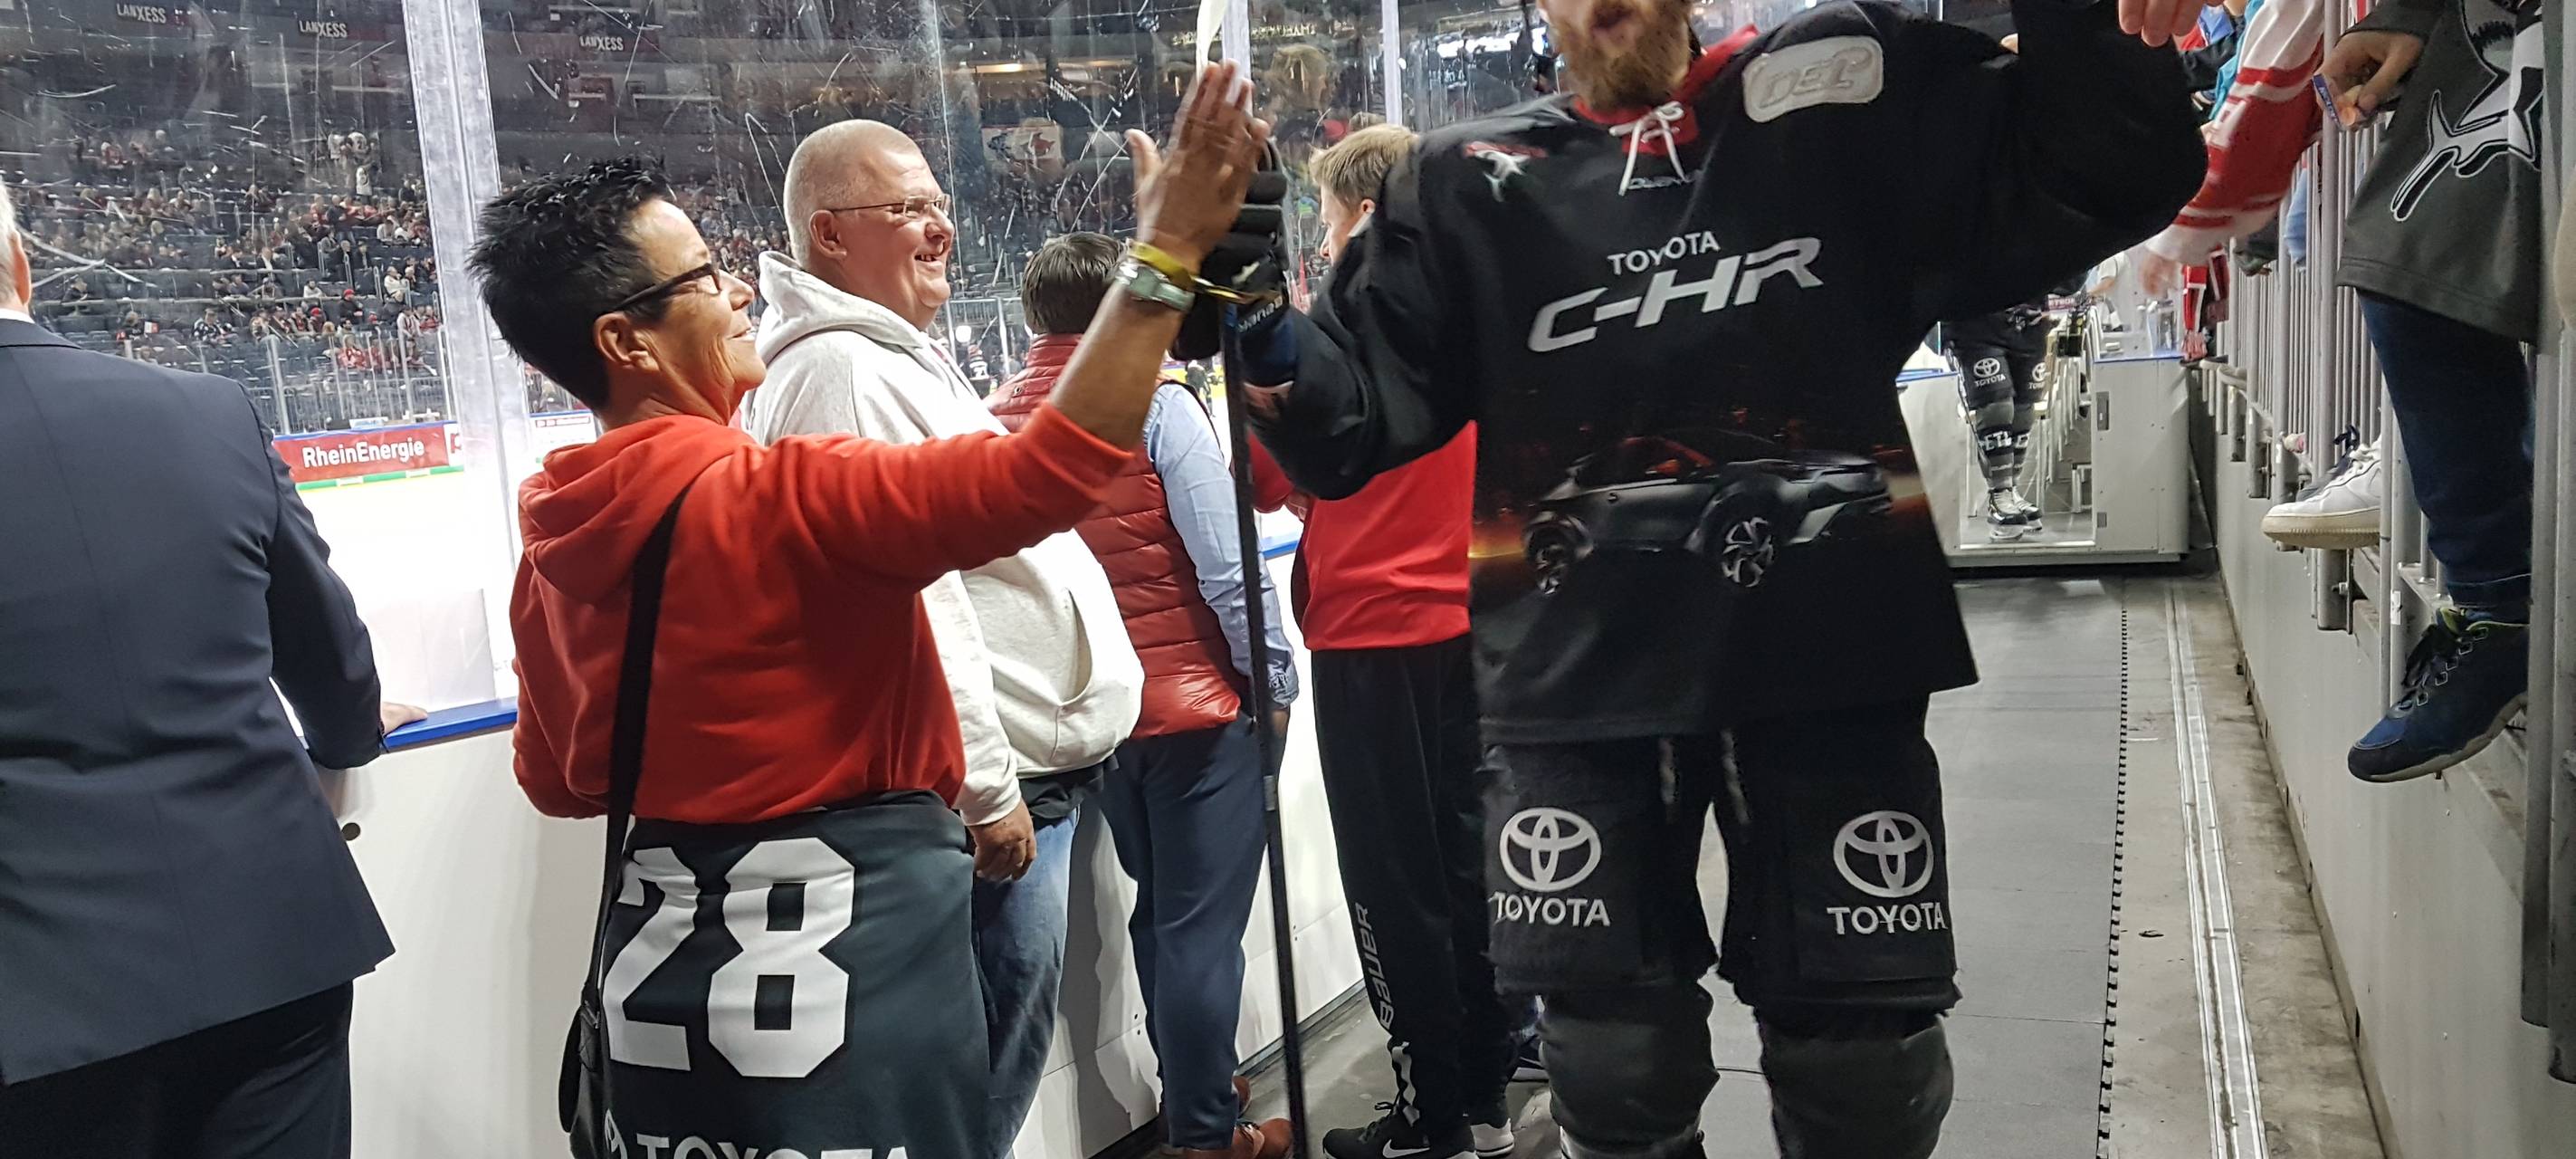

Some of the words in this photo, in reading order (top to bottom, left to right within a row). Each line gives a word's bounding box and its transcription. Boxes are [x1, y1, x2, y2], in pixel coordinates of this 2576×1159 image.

[116, 3, 167, 24] LANXESS
[299, 20, 348, 38] LANXESS
[579, 35, 624, 51] LANXESS
[1608, 230, 1721, 275] TOYOTA
[1528, 237, 1824, 352] C-HR
[1975, 373, 2006, 388] TOYOTA
[301, 436, 425, 468] RheinEnergie
[1490, 891, 1611, 927] TOYOTA
[1826, 902, 1949, 935] TOYOTA
[603, 837, 855, 1078] 28
[1355, 902, 1395, 1030] BAUER
